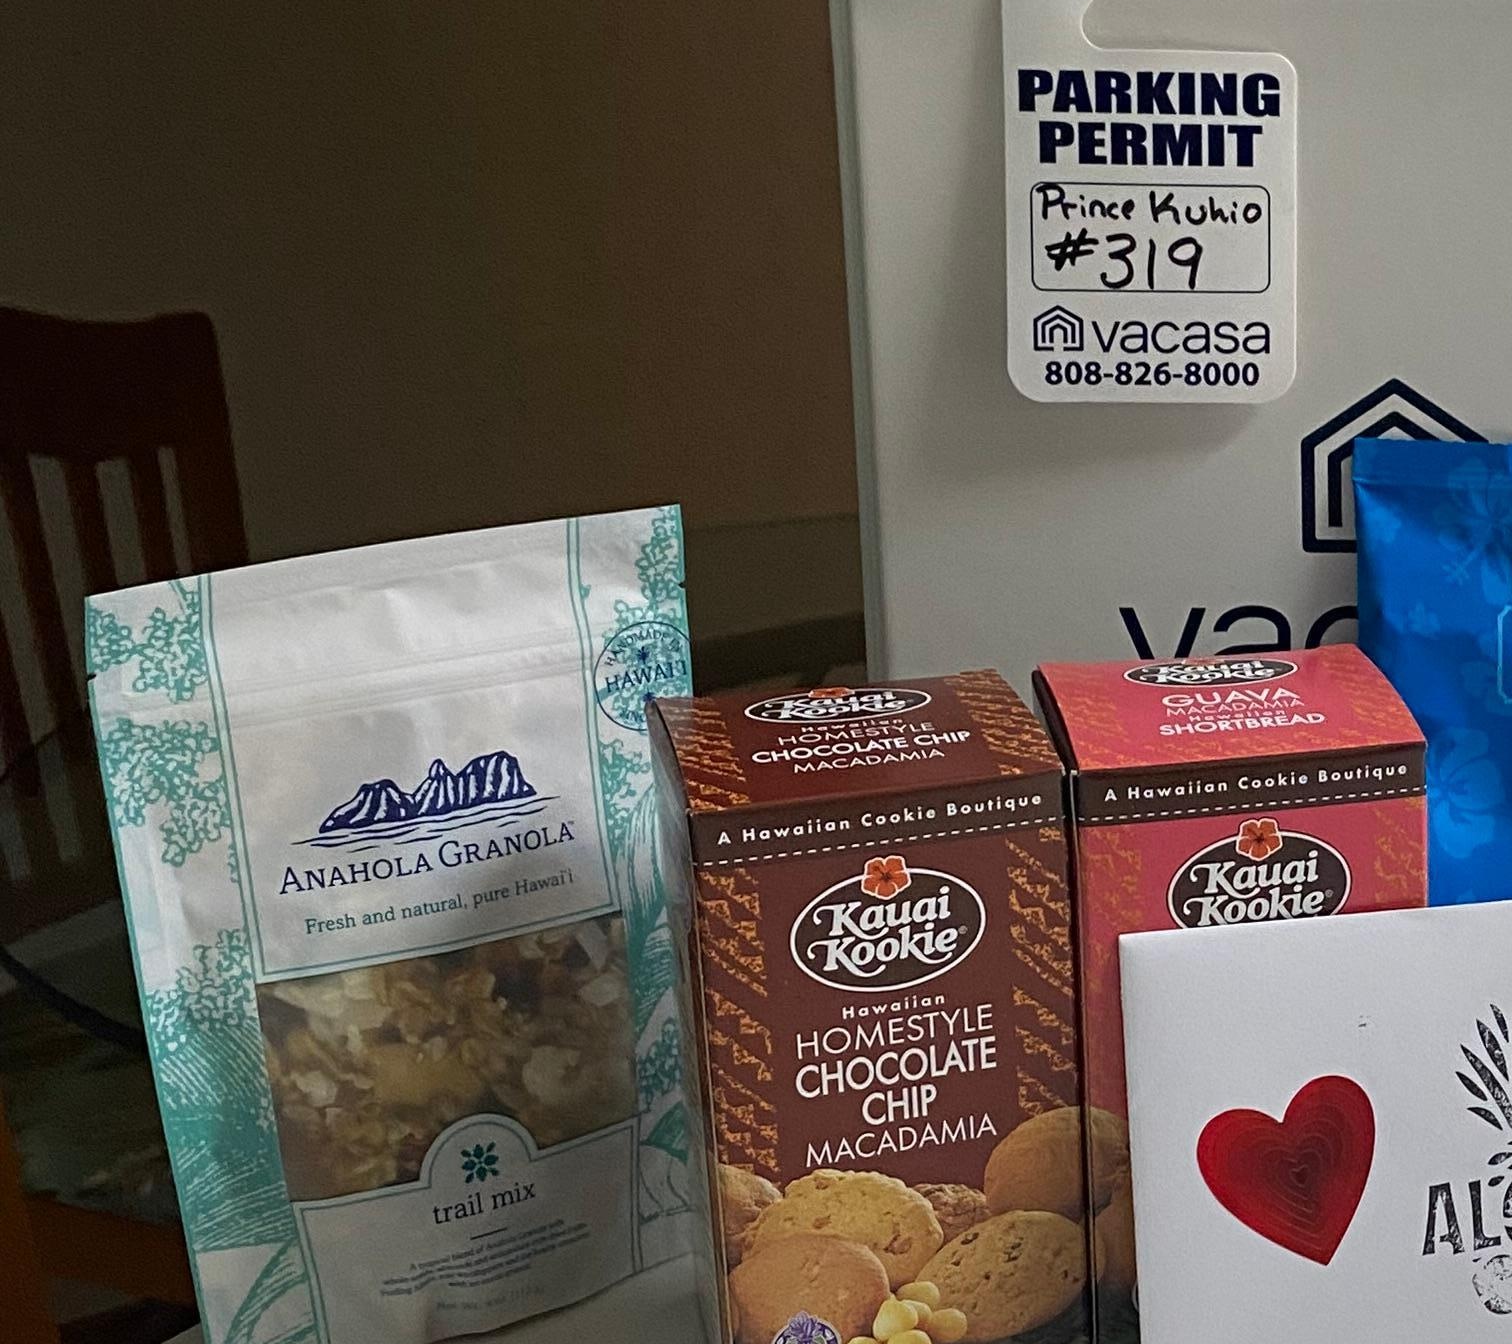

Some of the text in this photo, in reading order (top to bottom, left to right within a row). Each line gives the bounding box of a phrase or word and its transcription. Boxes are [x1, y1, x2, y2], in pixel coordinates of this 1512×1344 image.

[1017, 69, 1281, 118] PARKING
[1038, 121, 1264, 167] PERMIT
[1036, 185, 1263, 226] Prince Kuhio
[1045, 228, 1204, 290] #319
[1091, 319, 1271, 354] vacasa
[1044, 361, 1260, 387] 808-826-8000
[1161, 687, 1301, 707] GUAVA
[1166, 699, 1305, 717] MACADAMIA
[778, 722, 935, 746] HOMESTYLE
[1159, 713, 1326, 736] SHORTBREAD
[751, 730, 972, 763] CHOCOLATE CHIP
[793, 748, 945, 774] MACADAMIA
[1104, 762, 1408, 802] A Hawaiian Cookie Boutique
[717, 793, 1043, 846] A Hawaiian Cookie Boutique
[279, 822, 574, 895] ANAHOLA GRANOLA
[1189, 850, 1320, 900] Kauai
[304, 913, 358, 935] Fresh
[361, 906, 397, 926] and
[400, 894, 469, 919] natural,
[471, 886, 511, 911] pure
[812, 885, 952, 940] Kauai
[806, 920, 960, 978] Kookie
[842, 993, 946, 1020] Hawaiian
[796, 1003, 993, 1059] HOMESTYLE
[795, 1035, 997, 1099] CHOCOLATE
[862, 1084, 938, 1127] CHIP
[805, 1112, 998, 1168] MACADAMIA
[432, 1182, 537, 1225] trail mix
